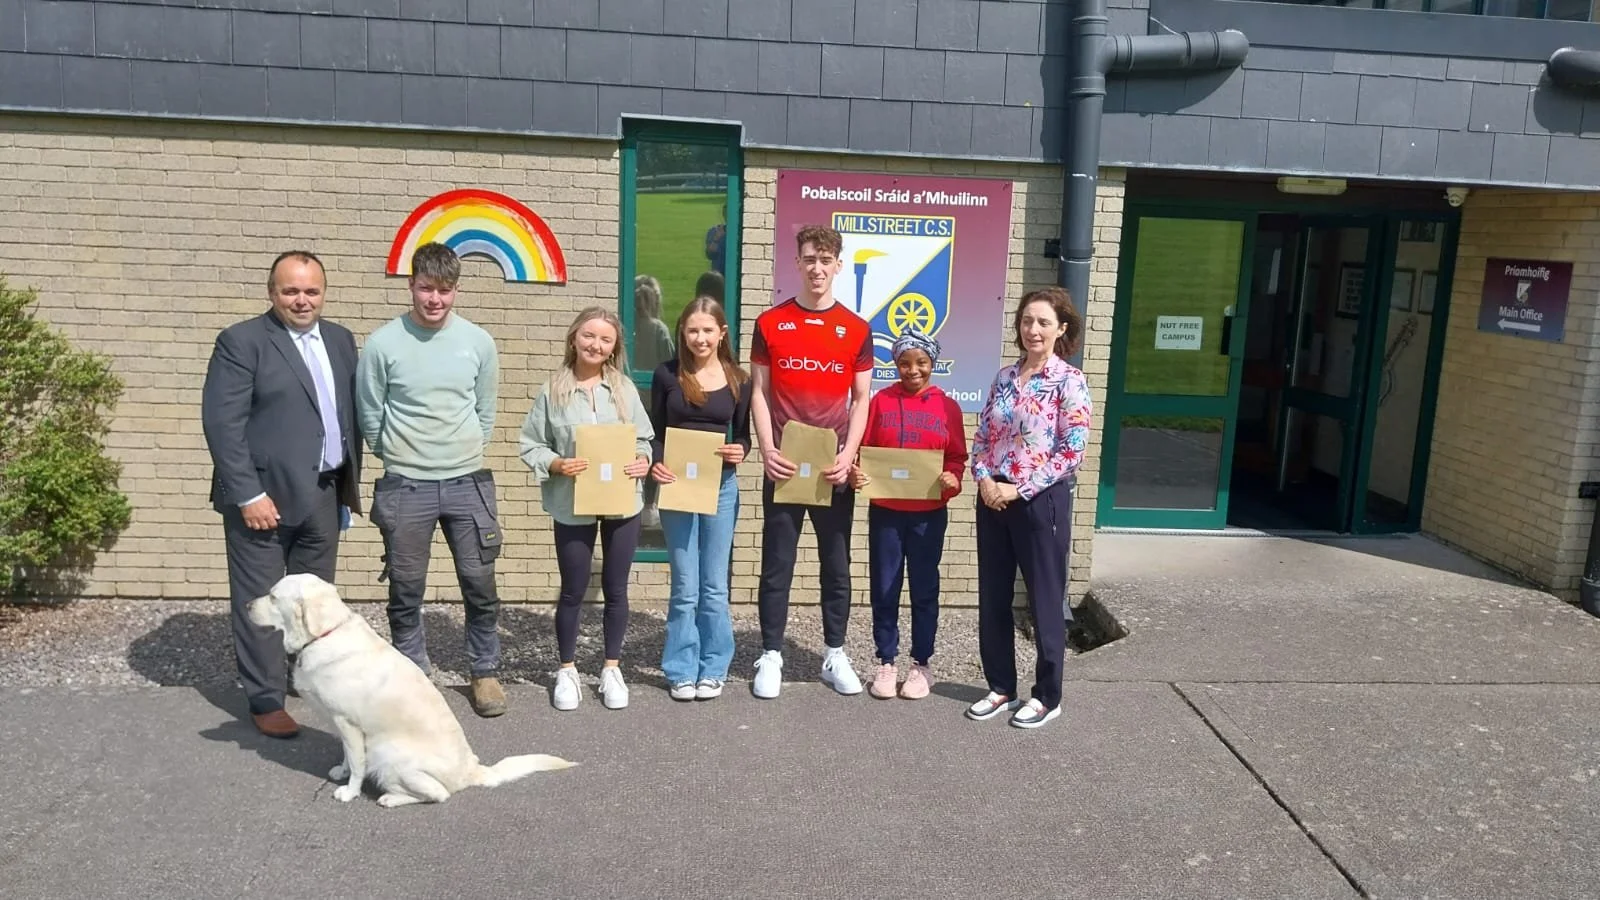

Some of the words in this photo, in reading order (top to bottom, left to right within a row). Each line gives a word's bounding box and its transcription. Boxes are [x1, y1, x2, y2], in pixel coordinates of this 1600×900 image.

[801, 185, 871, 201] Pobalscoil
[875, 189, 910, 203] Sráid
[837, 215, 921, 234] MILLSTREET
[924, 219, 951, 236] C.S.
[1498, 305, 1518, 318] Main
[1520, 308, 1543, 321] Office
[1179, 322, 1200, 330] FREE
[1162, 333, 1196, 341] CAMPUS
[777, 356, 845, 374] abbvie
[876, 369, 896, 378] DIES
[945, 388, 982, 402] chool
